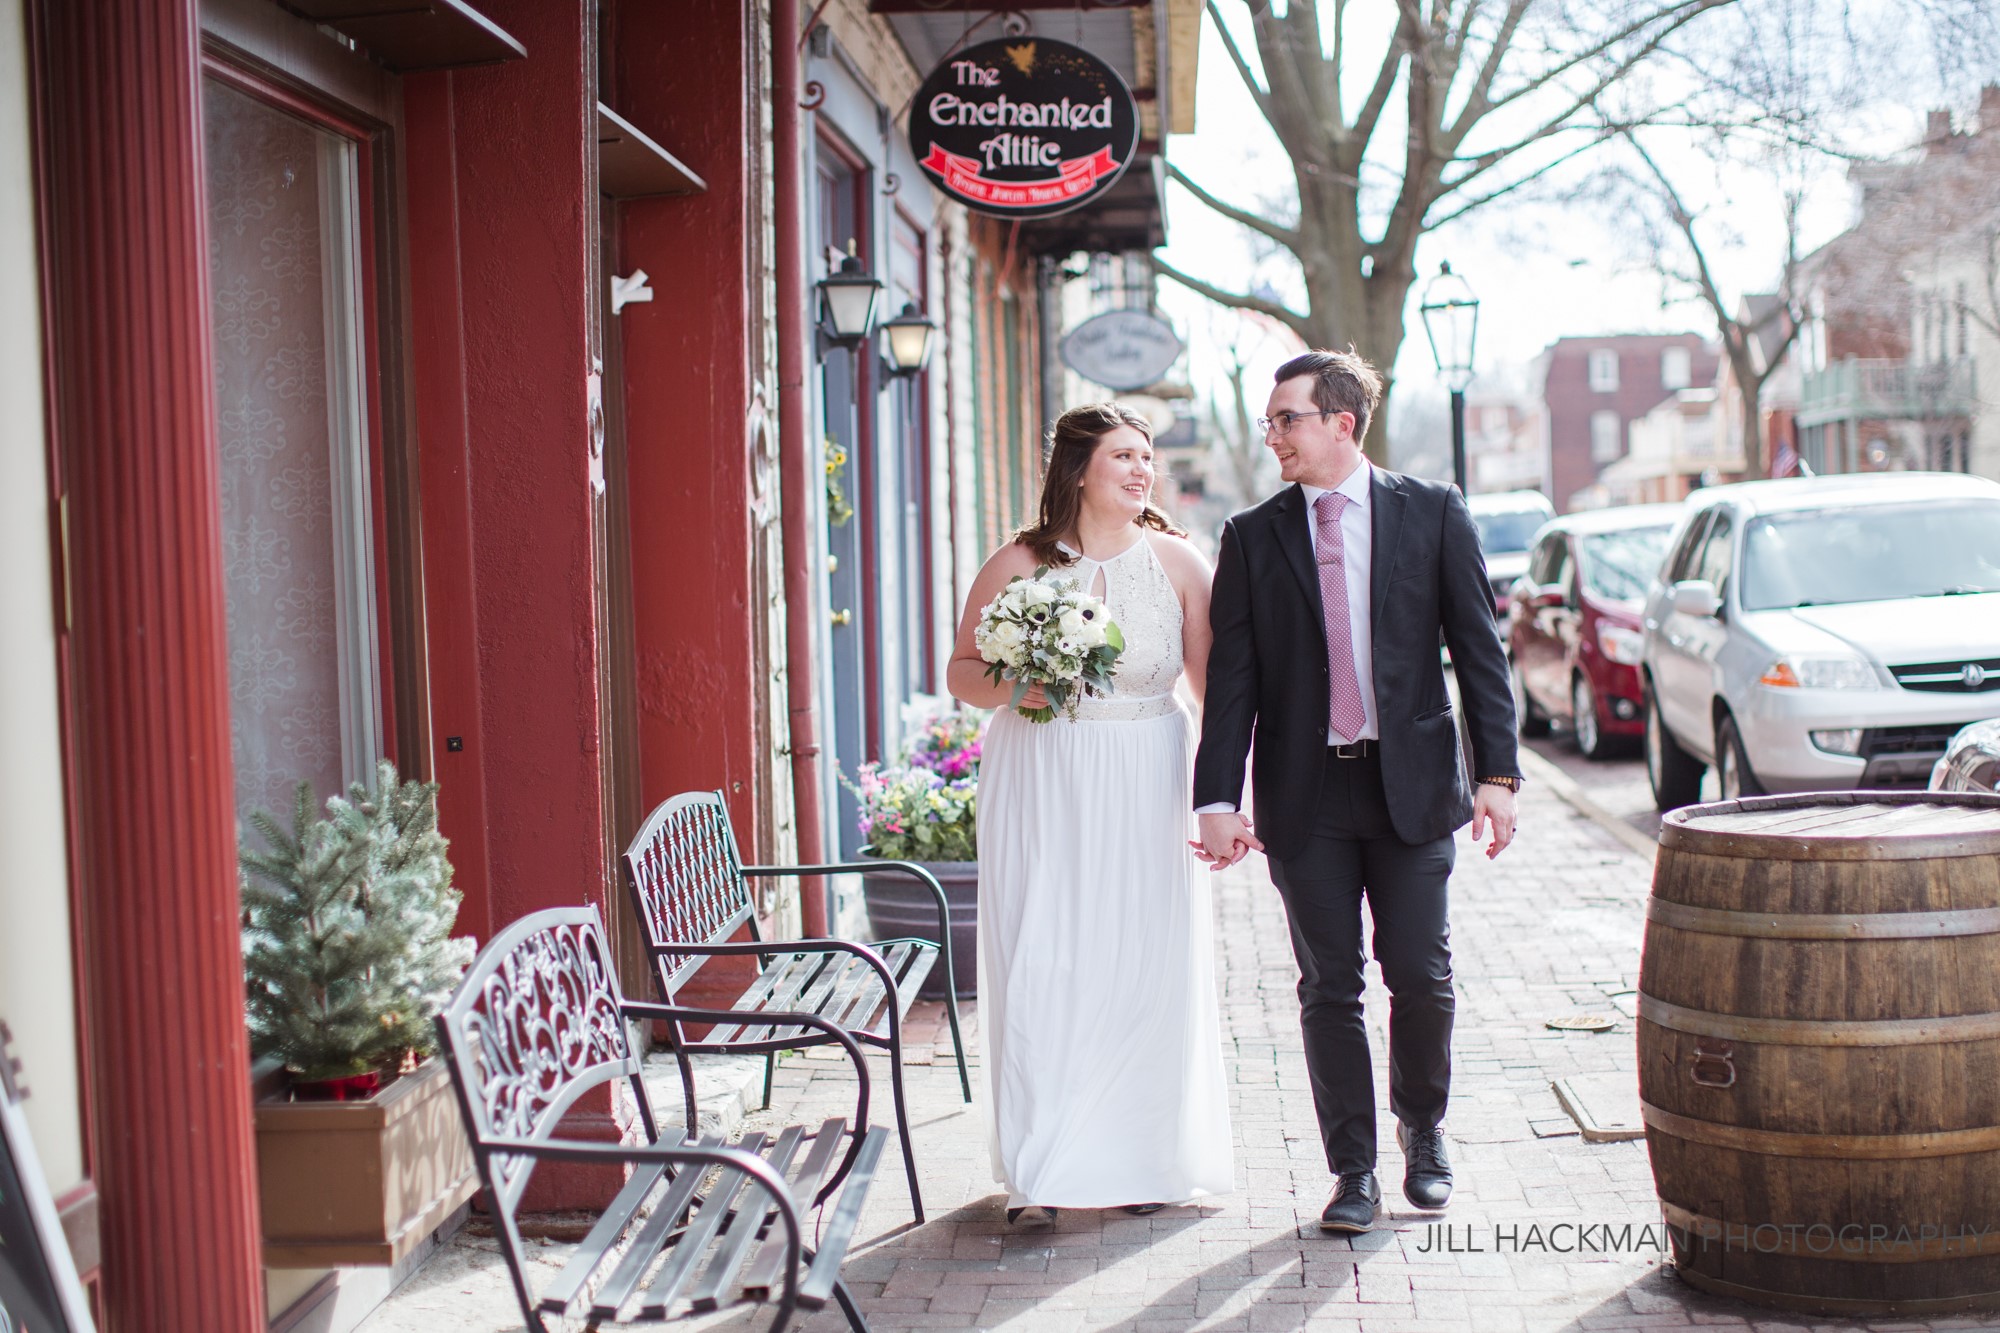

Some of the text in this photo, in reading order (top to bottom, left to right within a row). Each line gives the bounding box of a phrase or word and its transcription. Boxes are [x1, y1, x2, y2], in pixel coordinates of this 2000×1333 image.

[950, 60, 1001, 88] The
[929, 92, 1112, 131] Enchanted
[979, 132, 1062, 171] Attic
